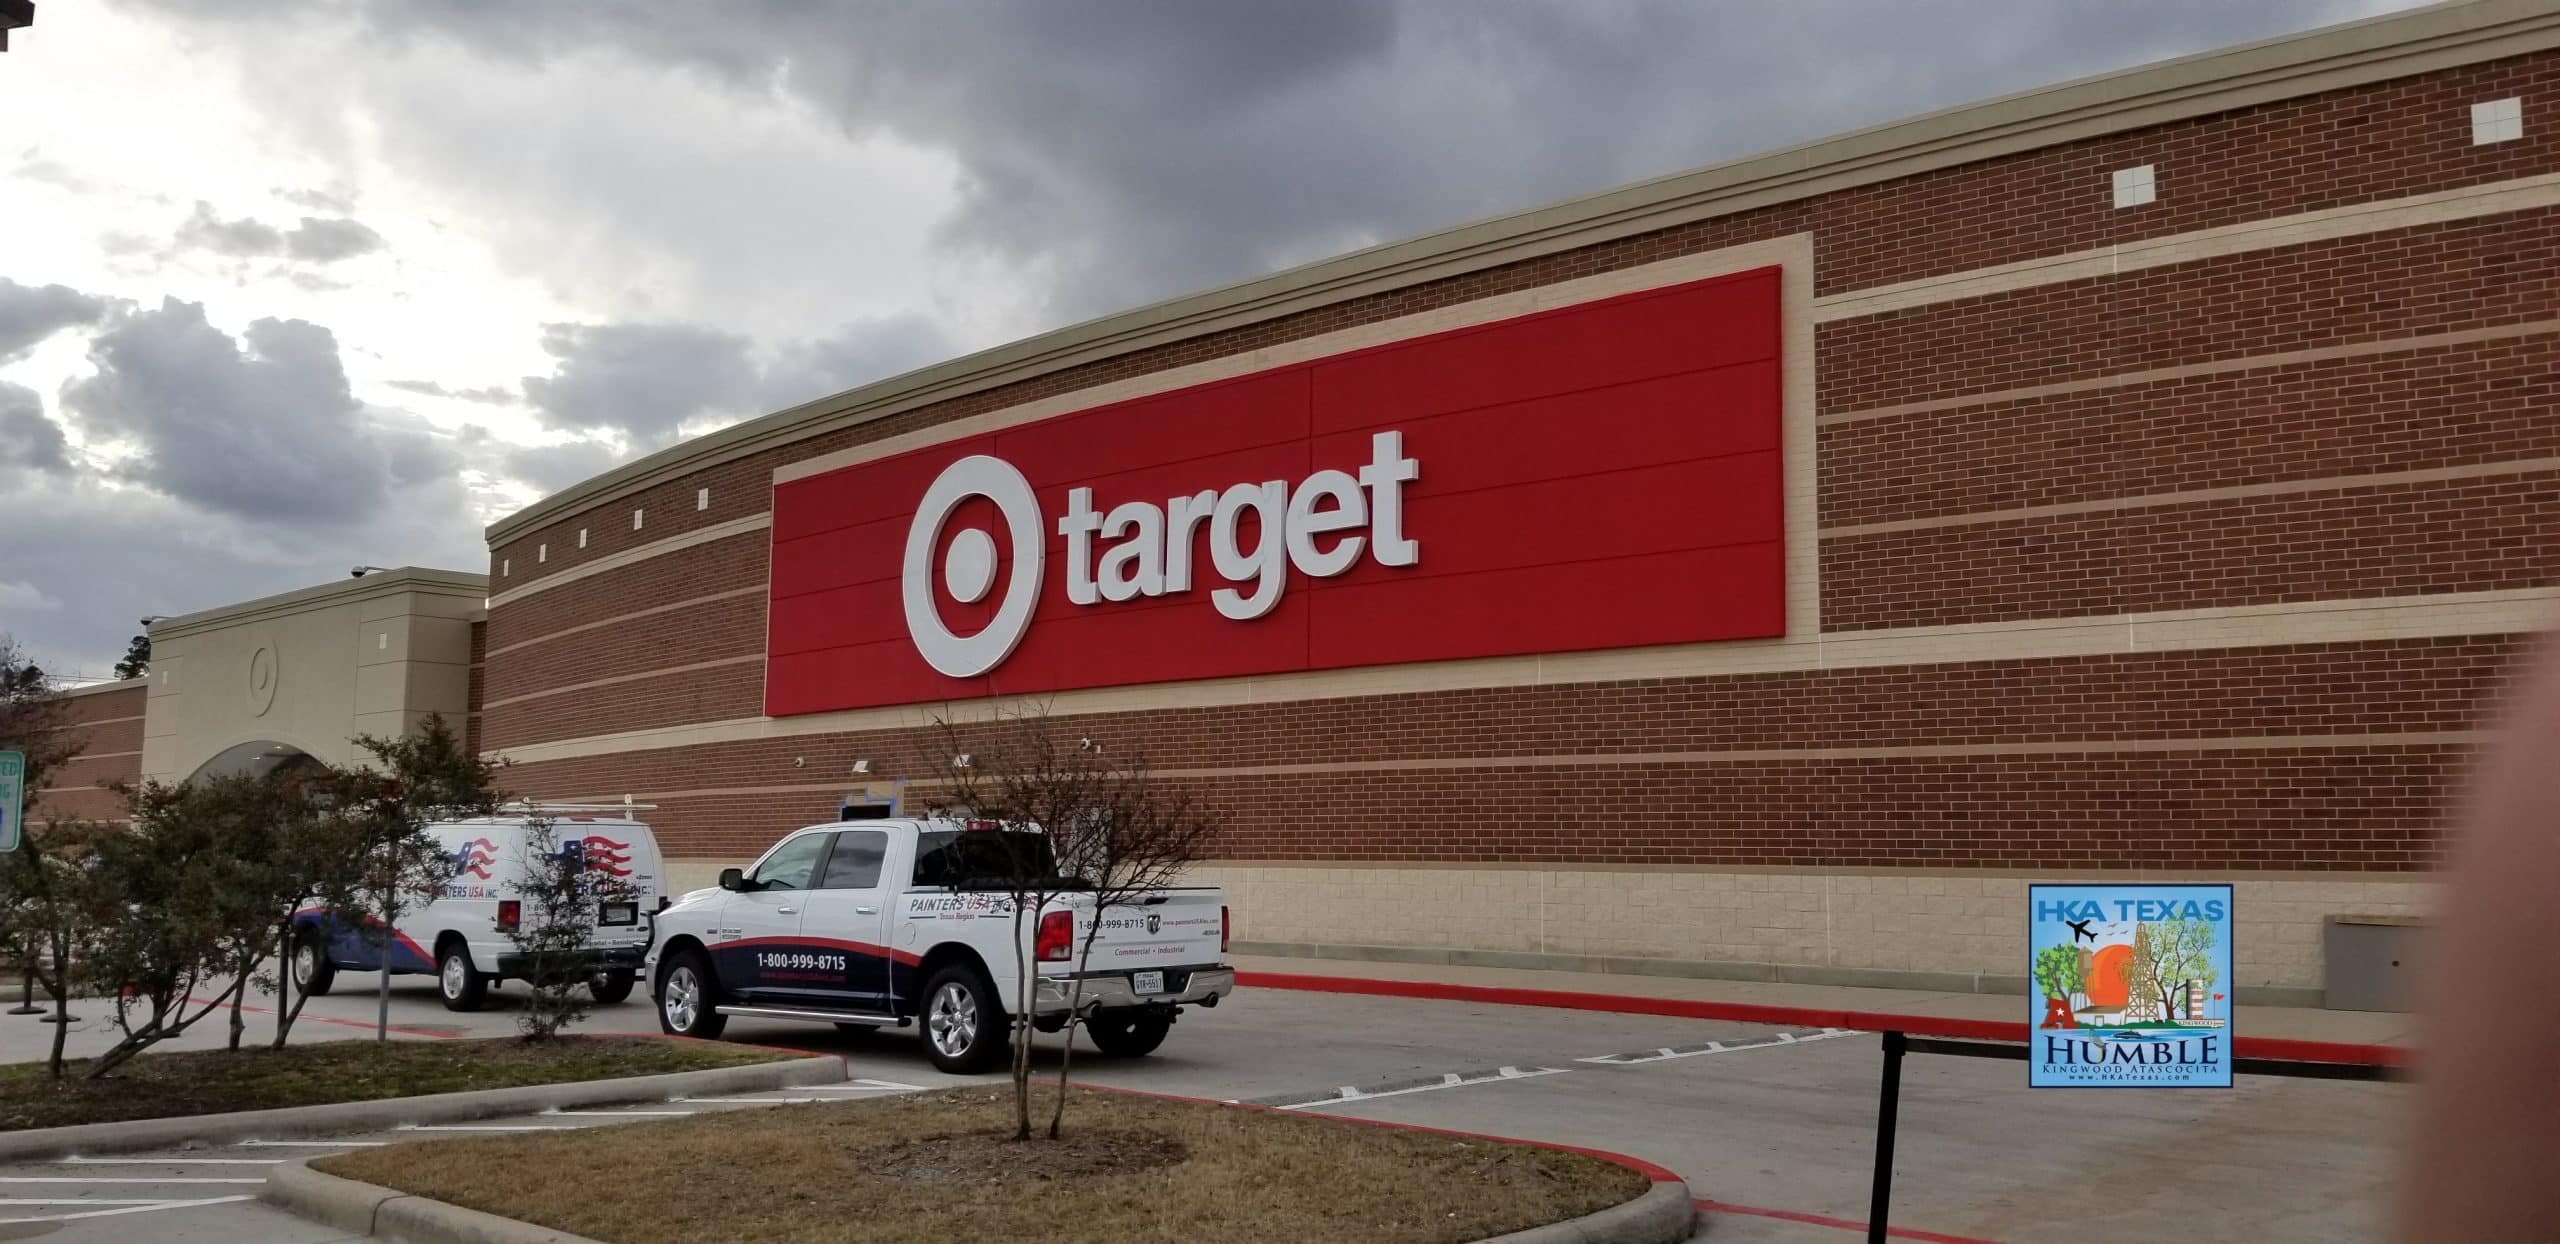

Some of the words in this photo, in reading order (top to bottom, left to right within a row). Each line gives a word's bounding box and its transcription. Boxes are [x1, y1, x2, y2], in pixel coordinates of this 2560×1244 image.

[1058, 430, 1419, 620] target
[469, 886, 484, 897] USA
[910, 898, 964, 912] PAINTERS
[1114, 948, 1150, 957] Commercial
[1157, 946, 1185, 955] Industrial
[757, 953, 846, 970] 1-800-999-8715
